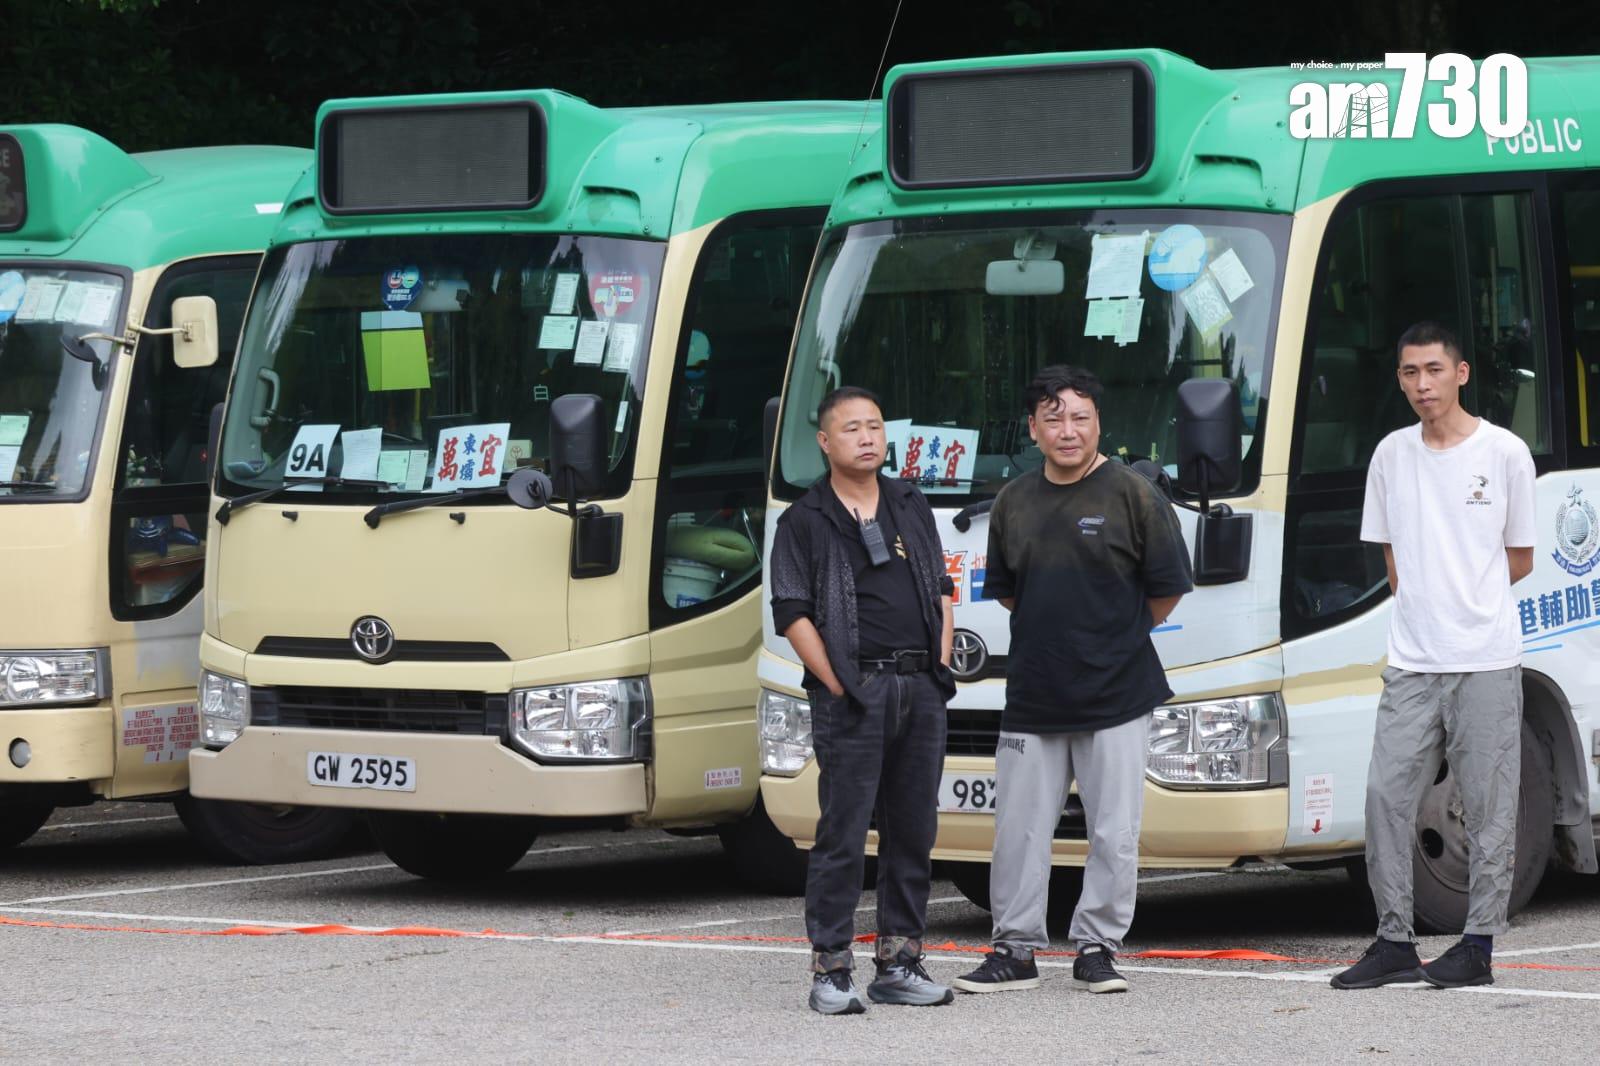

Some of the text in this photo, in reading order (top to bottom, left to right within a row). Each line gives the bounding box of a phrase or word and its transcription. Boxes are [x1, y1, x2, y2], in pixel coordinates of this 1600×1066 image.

[290, 443, 325, 472] 9A
[314, 755, 408, 786] GW 2595
